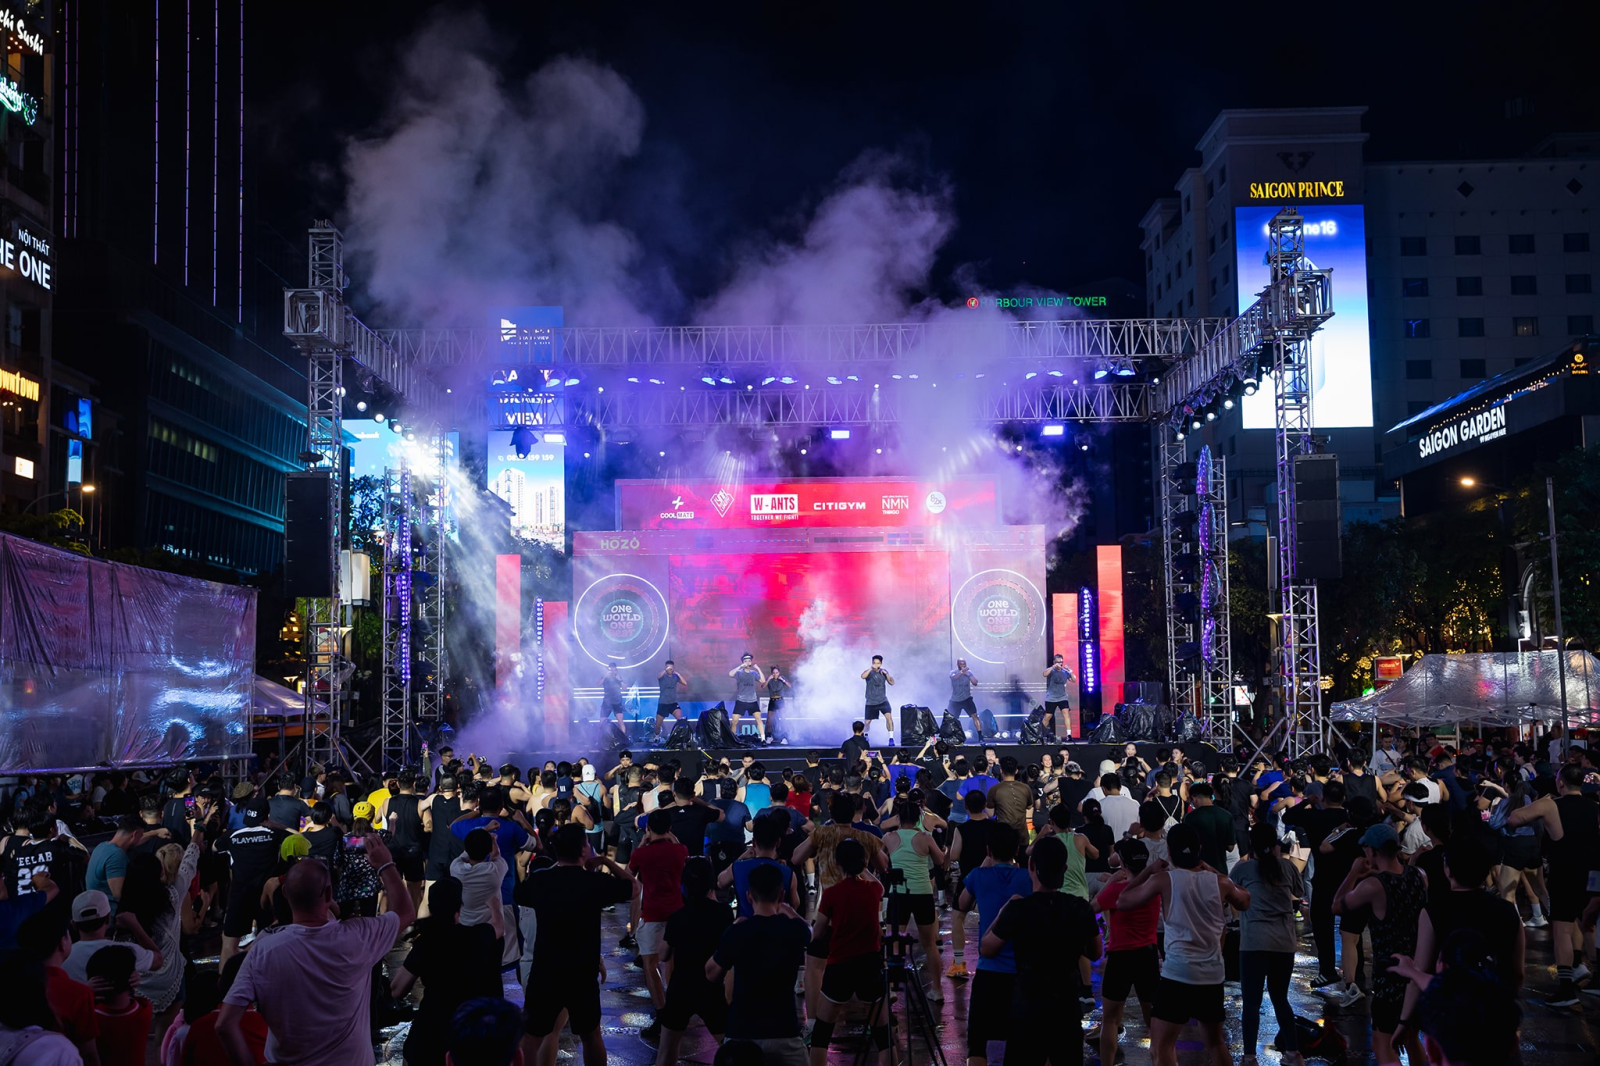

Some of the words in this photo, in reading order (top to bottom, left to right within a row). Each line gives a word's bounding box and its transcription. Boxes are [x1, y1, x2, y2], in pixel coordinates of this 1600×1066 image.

[17, 19, 43, 56] Sushi
[1250, 182, 1296, 198] SAIGON
[1298, 181, 1344, 197] PRINCE
[19, 250, 51, 290] ONE
[982, 298, 1033, 308] RBOUR
[1037, 298, 1063, 307] VIEW
[1066, 297, 1107, 306] TOWER
[1419, 425, 1458, 459] SAIGON
[1460, 404, 1506, 442] GARDEN
[813, 502, 866, 510] CITIGYM
[882, 498, 909, 510] NMN
[231, 835, 273, 844] PLAYWELL
[16, 852, 53, 867] EELAB
[17, 865, 50, 896] 2
